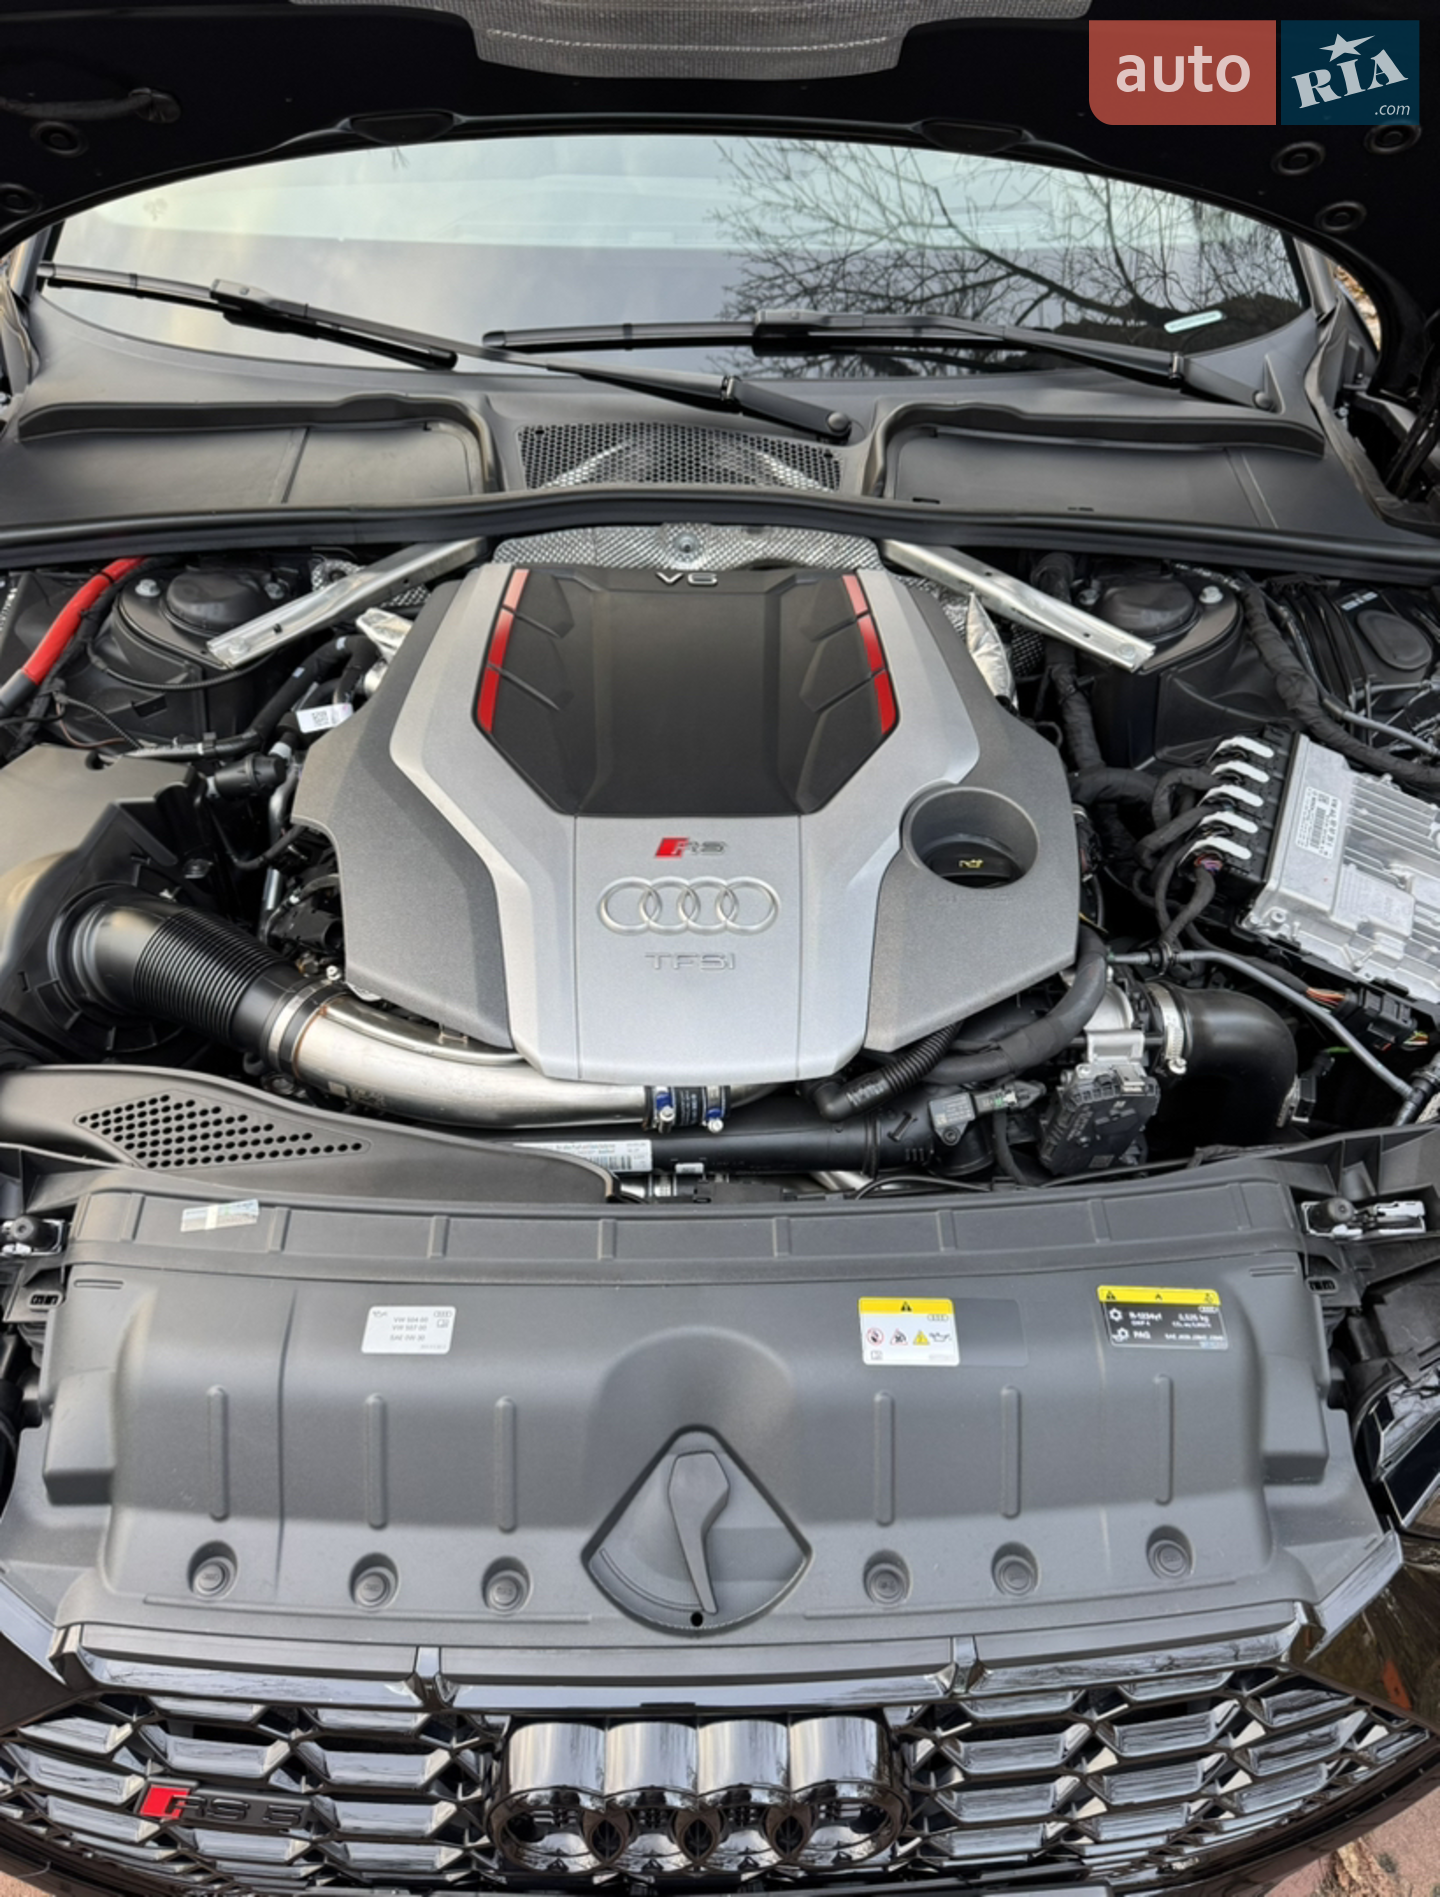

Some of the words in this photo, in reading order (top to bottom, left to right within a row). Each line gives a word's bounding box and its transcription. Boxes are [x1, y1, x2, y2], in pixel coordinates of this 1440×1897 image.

[655, 571, 718, 586] V6
[644, 952, 736, 970] TFSI
[153, 1788, 250, 1821] RS
[263, 1804, 302, 1826] 5
